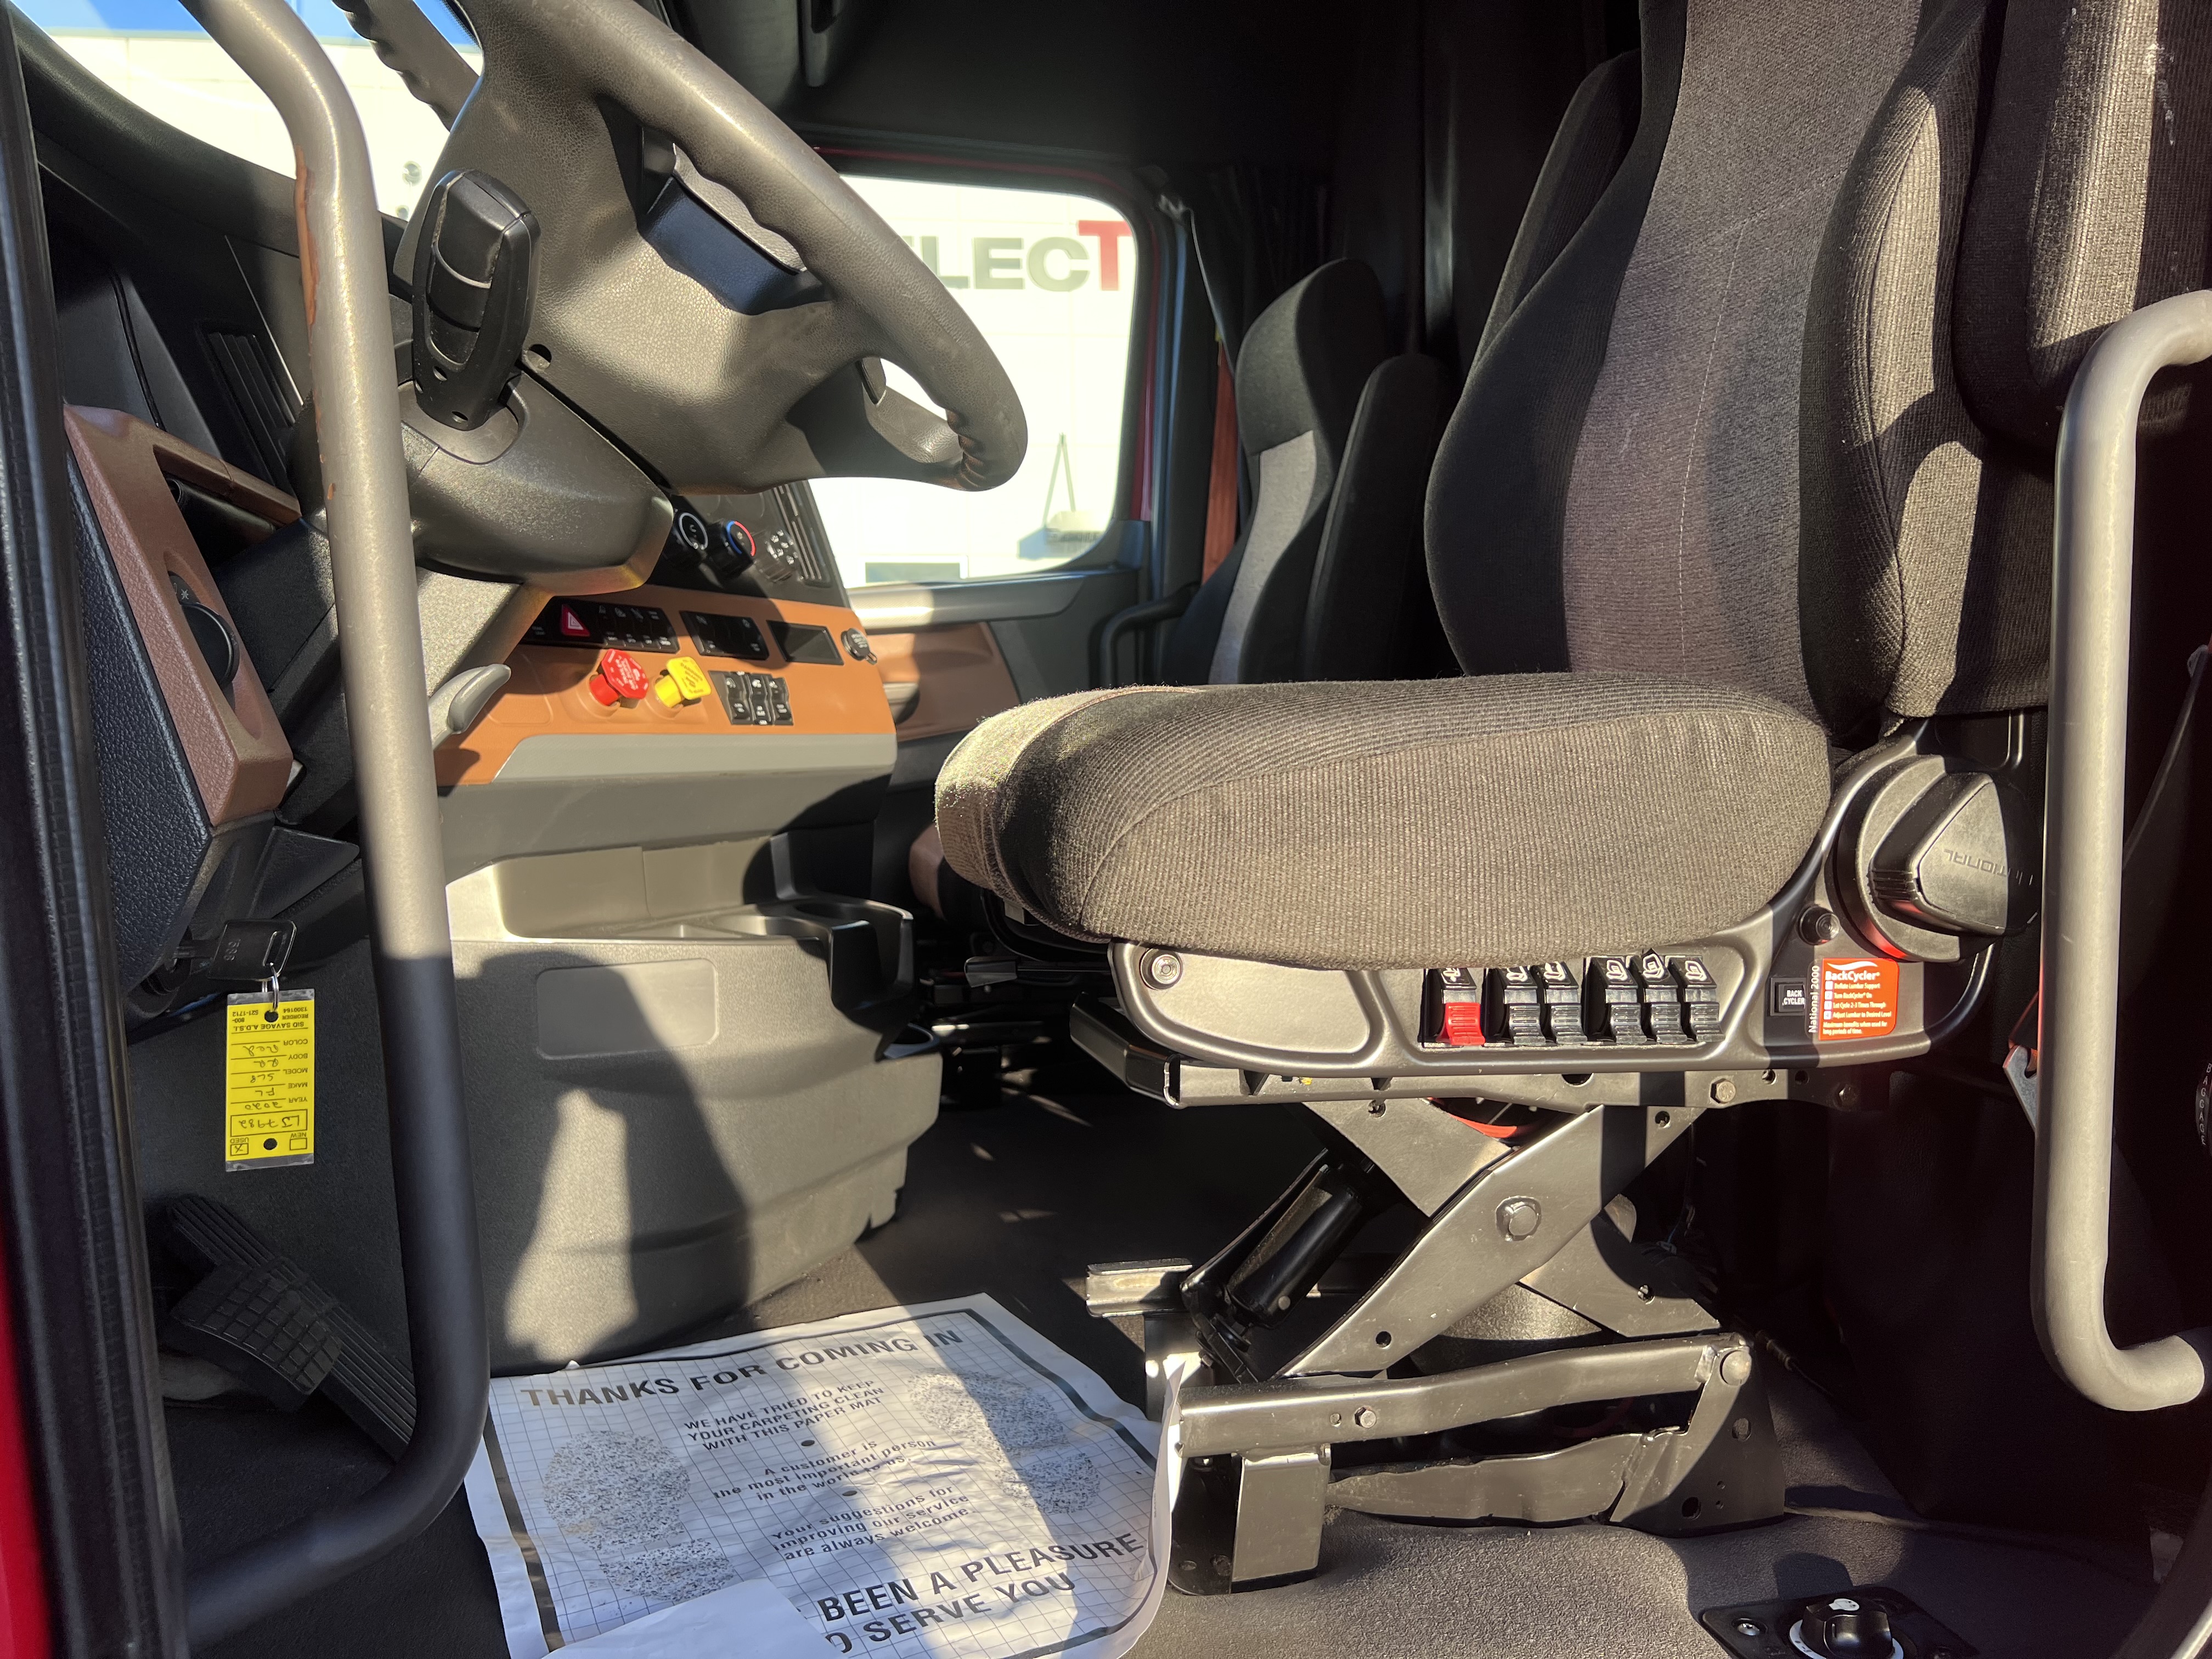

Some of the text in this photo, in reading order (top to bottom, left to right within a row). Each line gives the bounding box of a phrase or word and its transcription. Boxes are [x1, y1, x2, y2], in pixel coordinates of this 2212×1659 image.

[1808, 965, 1820, 1033] National 2000
[245, 1102, 283, 1110] 2020
[2199, 1063, 2212, 1146] BAGGAGE
[521, 1330, 963, 1406] THANKS FOR COMING IN
[684, 1380, 874, 1430] WE HAVE TRIED TO KEEP
[688, 1387, 885, 1441] YOUR CARPETING CLEAN
[702, 1397, 883, 1451] WITH THIS PAPER MAT
[714, 1440, 937, 1499] the most important person
[757, 1491, 774, 1501] in
[779, 1483, 808, 1496] the
[812, 1468, 860, 1488] world
[862, 1461, 882, 1472] to
[763, 1440, 877, 1476] A customer is
[771, 1485, 955, 1540] Your suggestions for
[774, 1494, 969, 1551] improving our service
[783, 1507, 975, 1560] are always welcome.
[817, 1533, 1145, 1622] BEEN A PLEASURE
[862, 1593, 992, 1643] SERVE
[994, 1572, 1076, 1604] YOU
